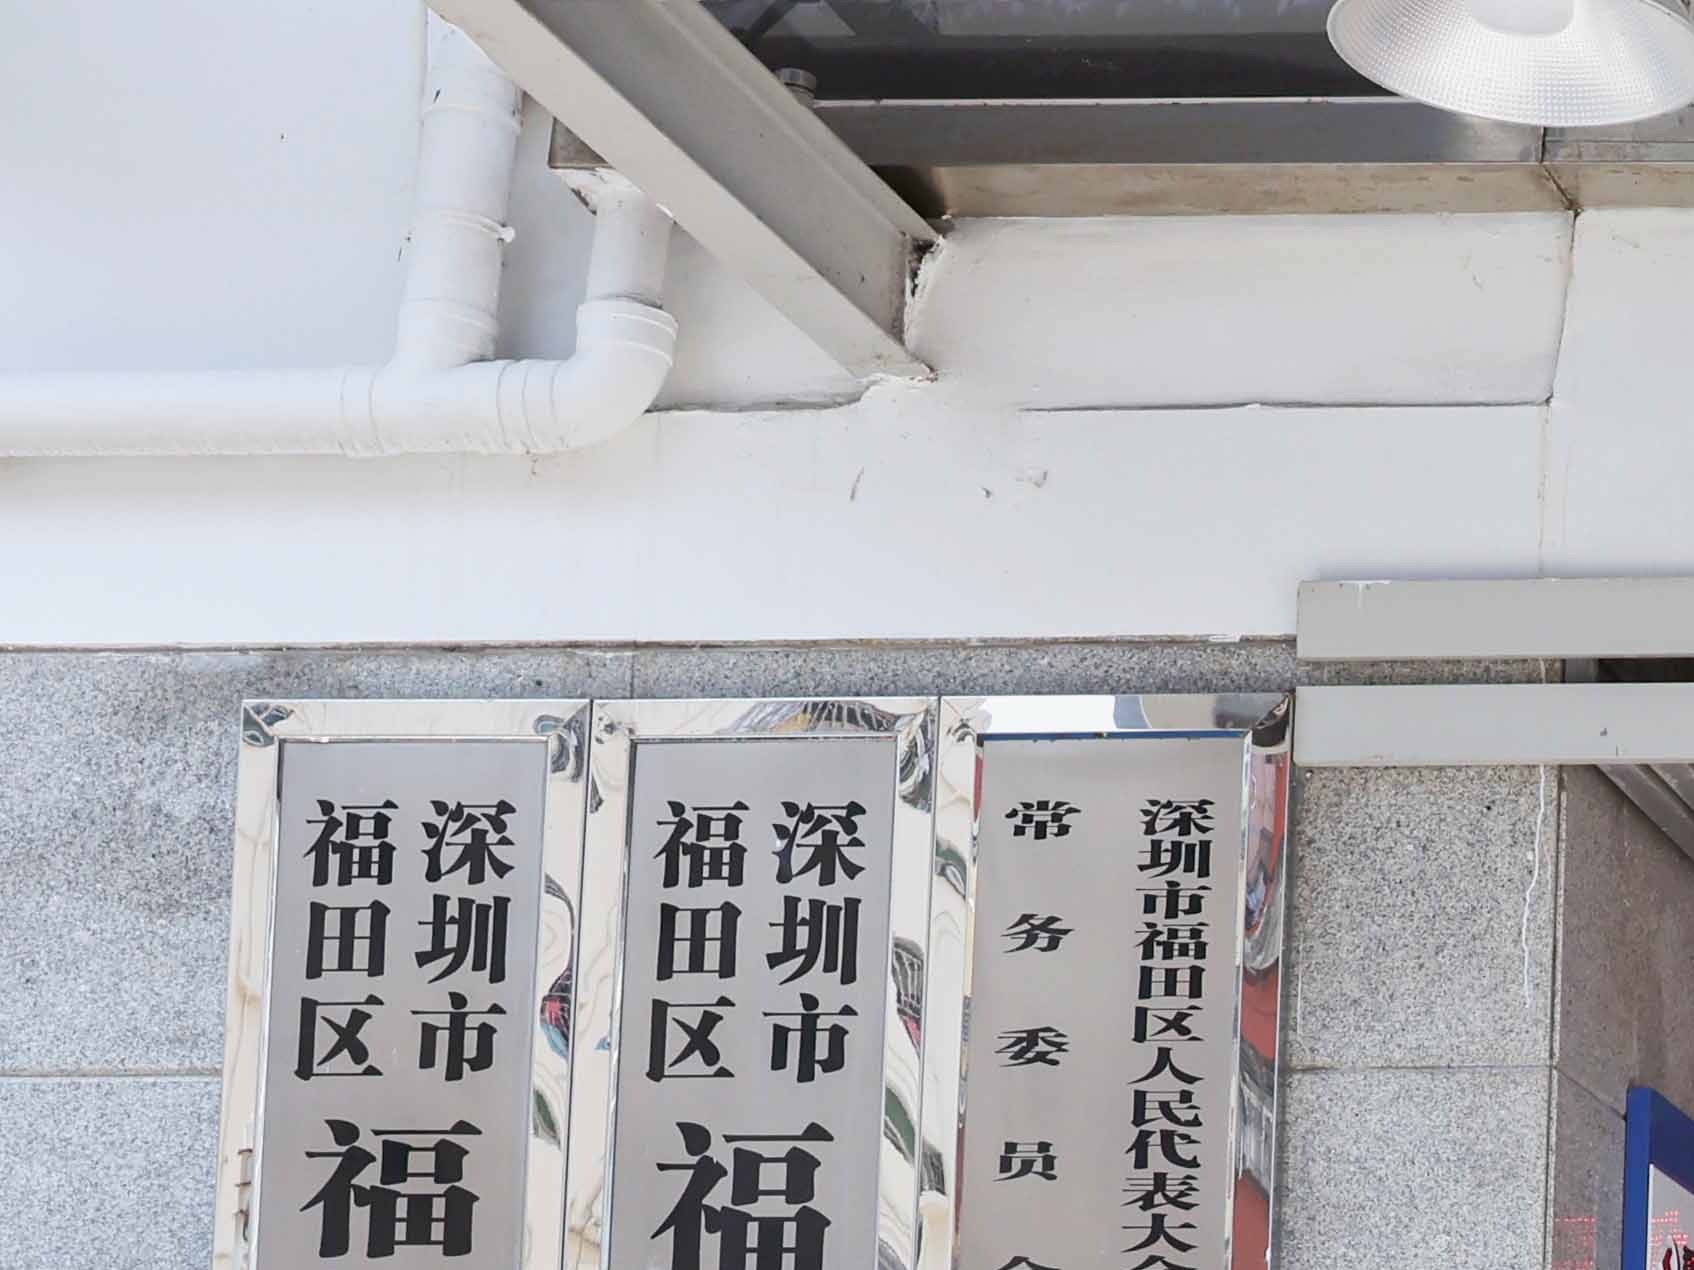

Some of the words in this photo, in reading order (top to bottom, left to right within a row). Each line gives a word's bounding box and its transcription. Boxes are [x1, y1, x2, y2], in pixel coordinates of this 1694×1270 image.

[295, 800, 398, 1080] 福田区
[411, 800, 515, 1081] 深圳市
[646, 801, 749, 1082] 福田区
[763, 801, 866, 1082] 深圳市
